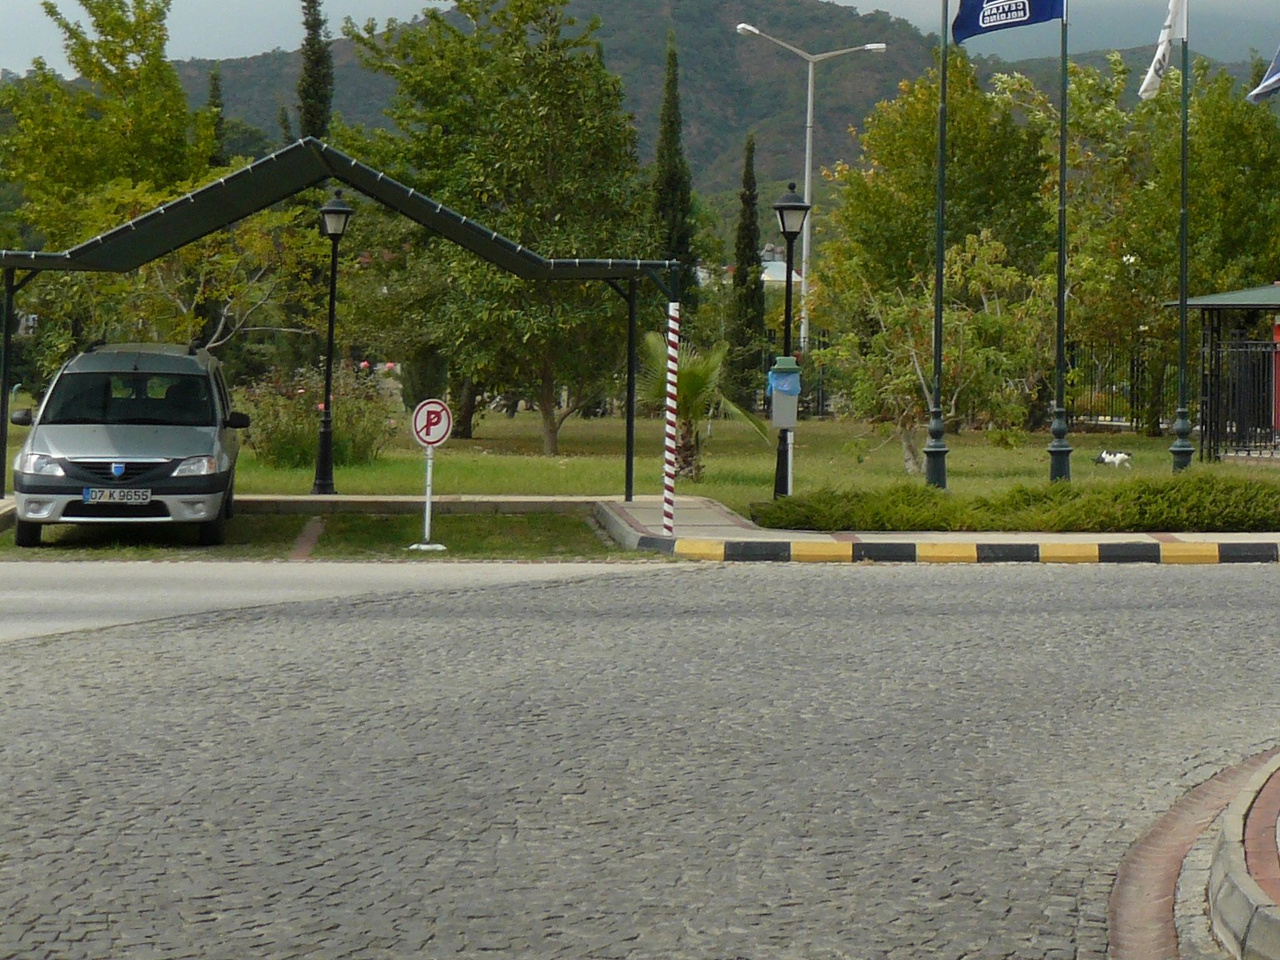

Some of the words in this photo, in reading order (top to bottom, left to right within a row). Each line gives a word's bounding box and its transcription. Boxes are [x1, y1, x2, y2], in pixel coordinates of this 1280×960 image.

[425, 410, 442, 437] P
[91, 490, 105, 500] 07
[109, 490, 116, 500] K
